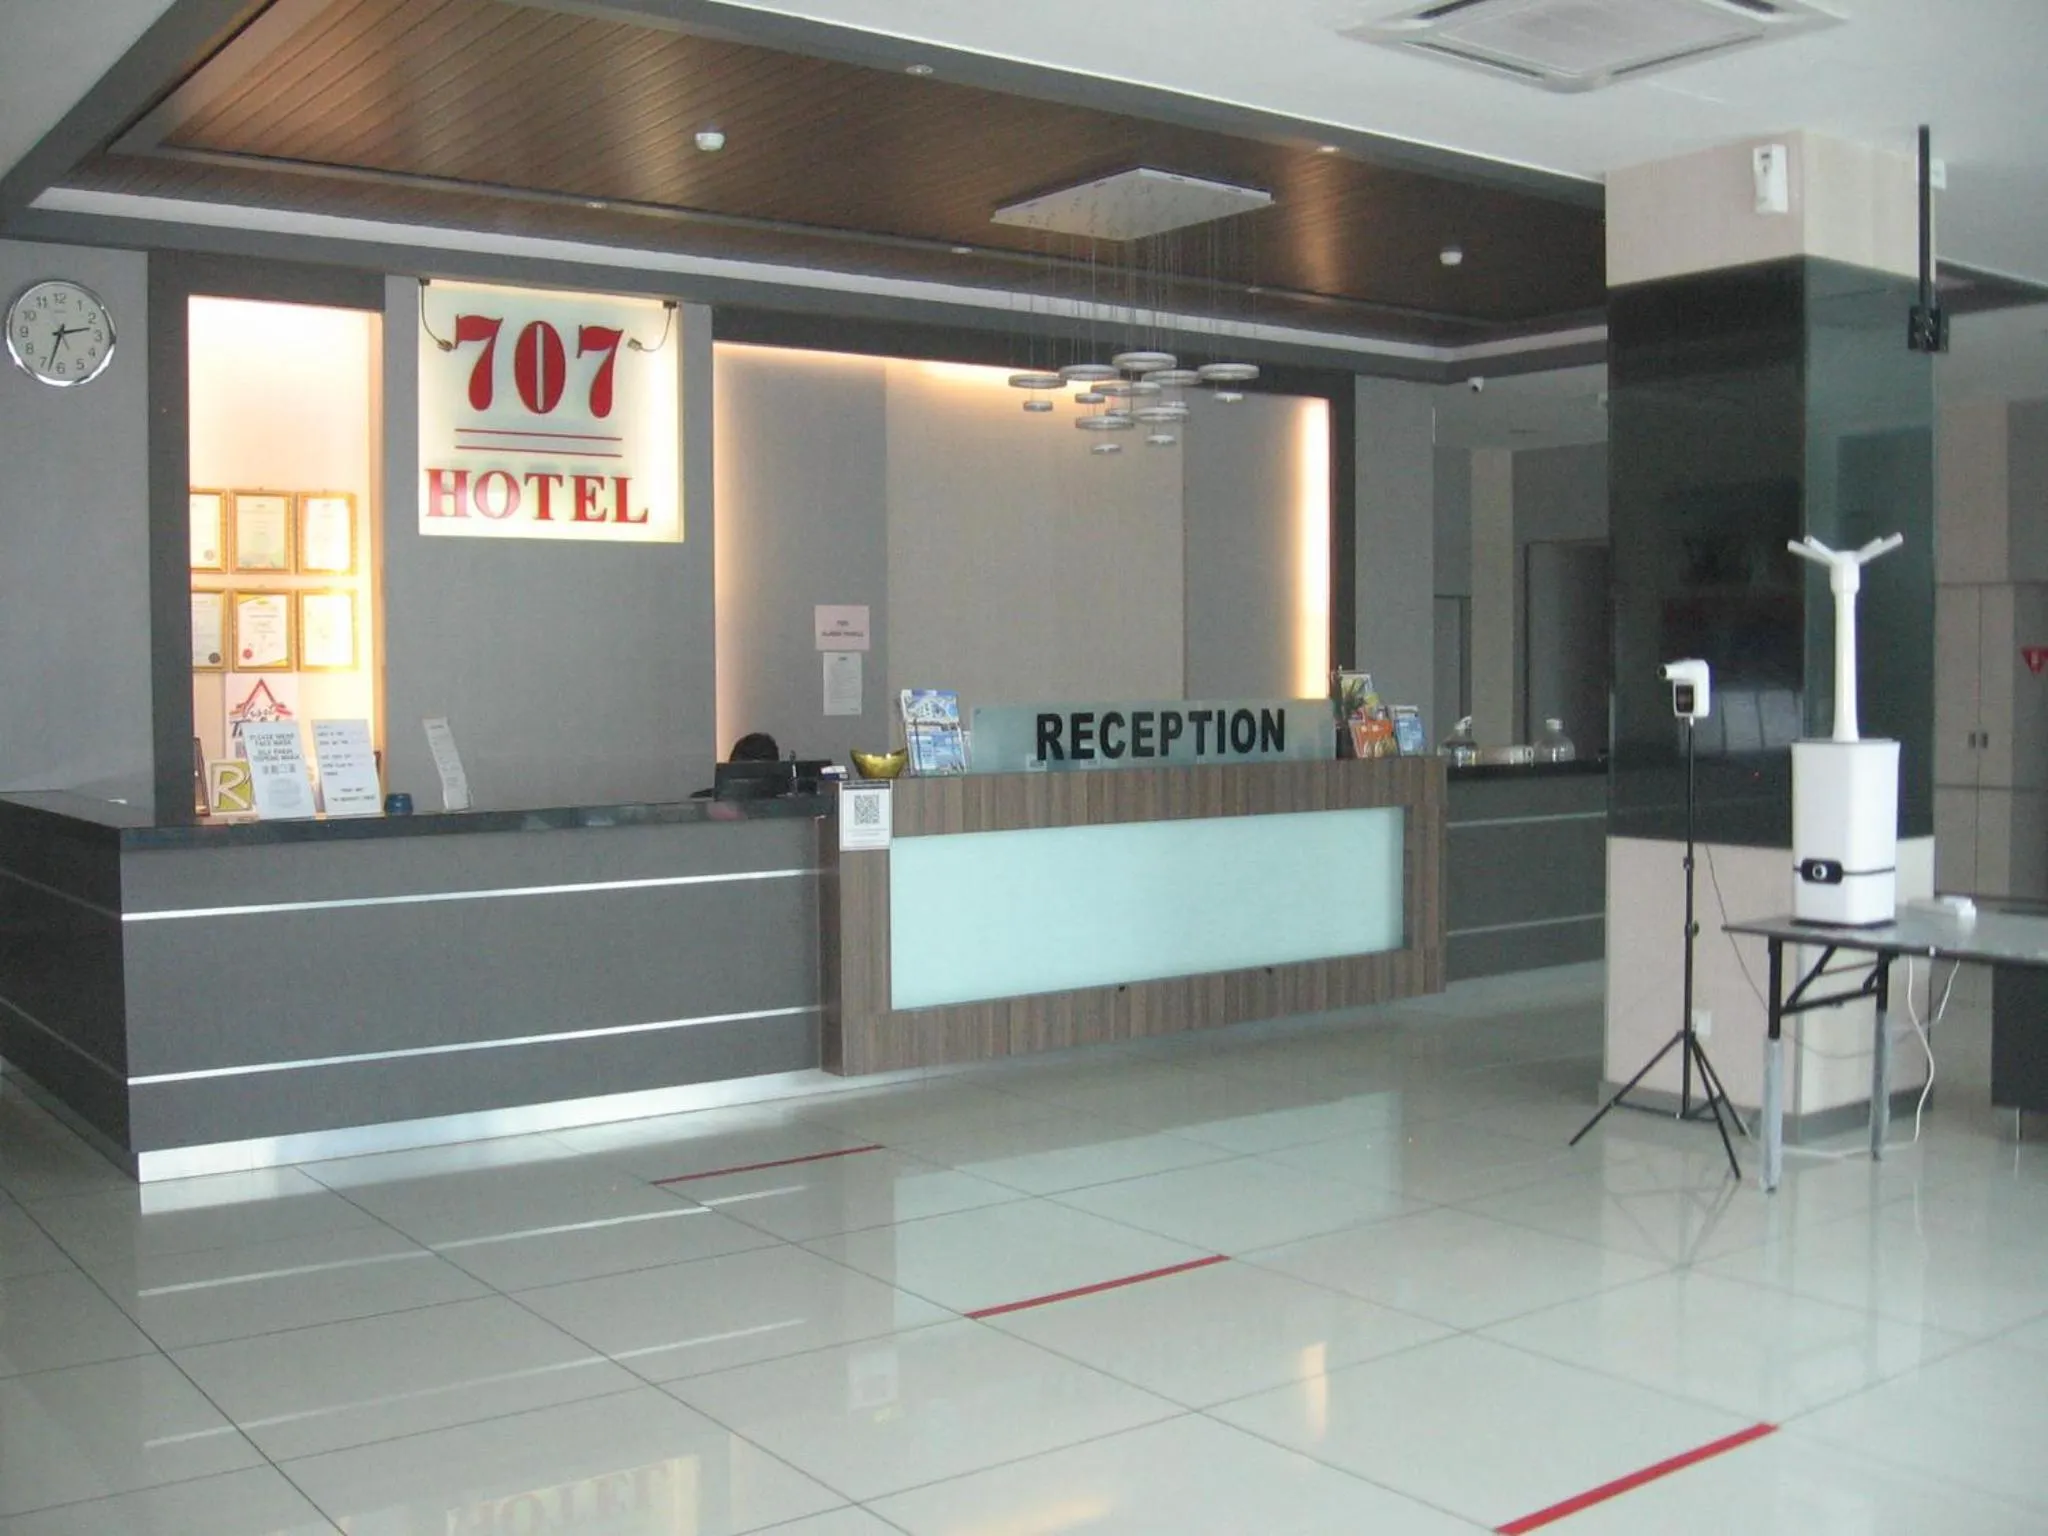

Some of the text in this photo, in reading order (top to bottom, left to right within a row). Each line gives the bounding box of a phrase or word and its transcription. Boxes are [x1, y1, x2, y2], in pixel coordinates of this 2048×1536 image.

[36, 295, 48, 309] 11
[53, 292, 66, 305] 12
[77, 299, 82, 312] 1
[22, 309, 37, 321] 10
[88, 312, 96, 325] 2
[20, 326, 28, 338] 9
[95, 329, 103, 342] 3
[26, 342, 34, 354] 8
[88, 347, 96, 357] 4
[39, 355, 48, 368] 7
[56, 362, 66, 374] 6
[76, 358, 85, 370] 5
[452, 313, 624, 420] 707
[424, 467, 649, 524] HOTEL
[1036, 708, 1286, 761] RECEPTION
